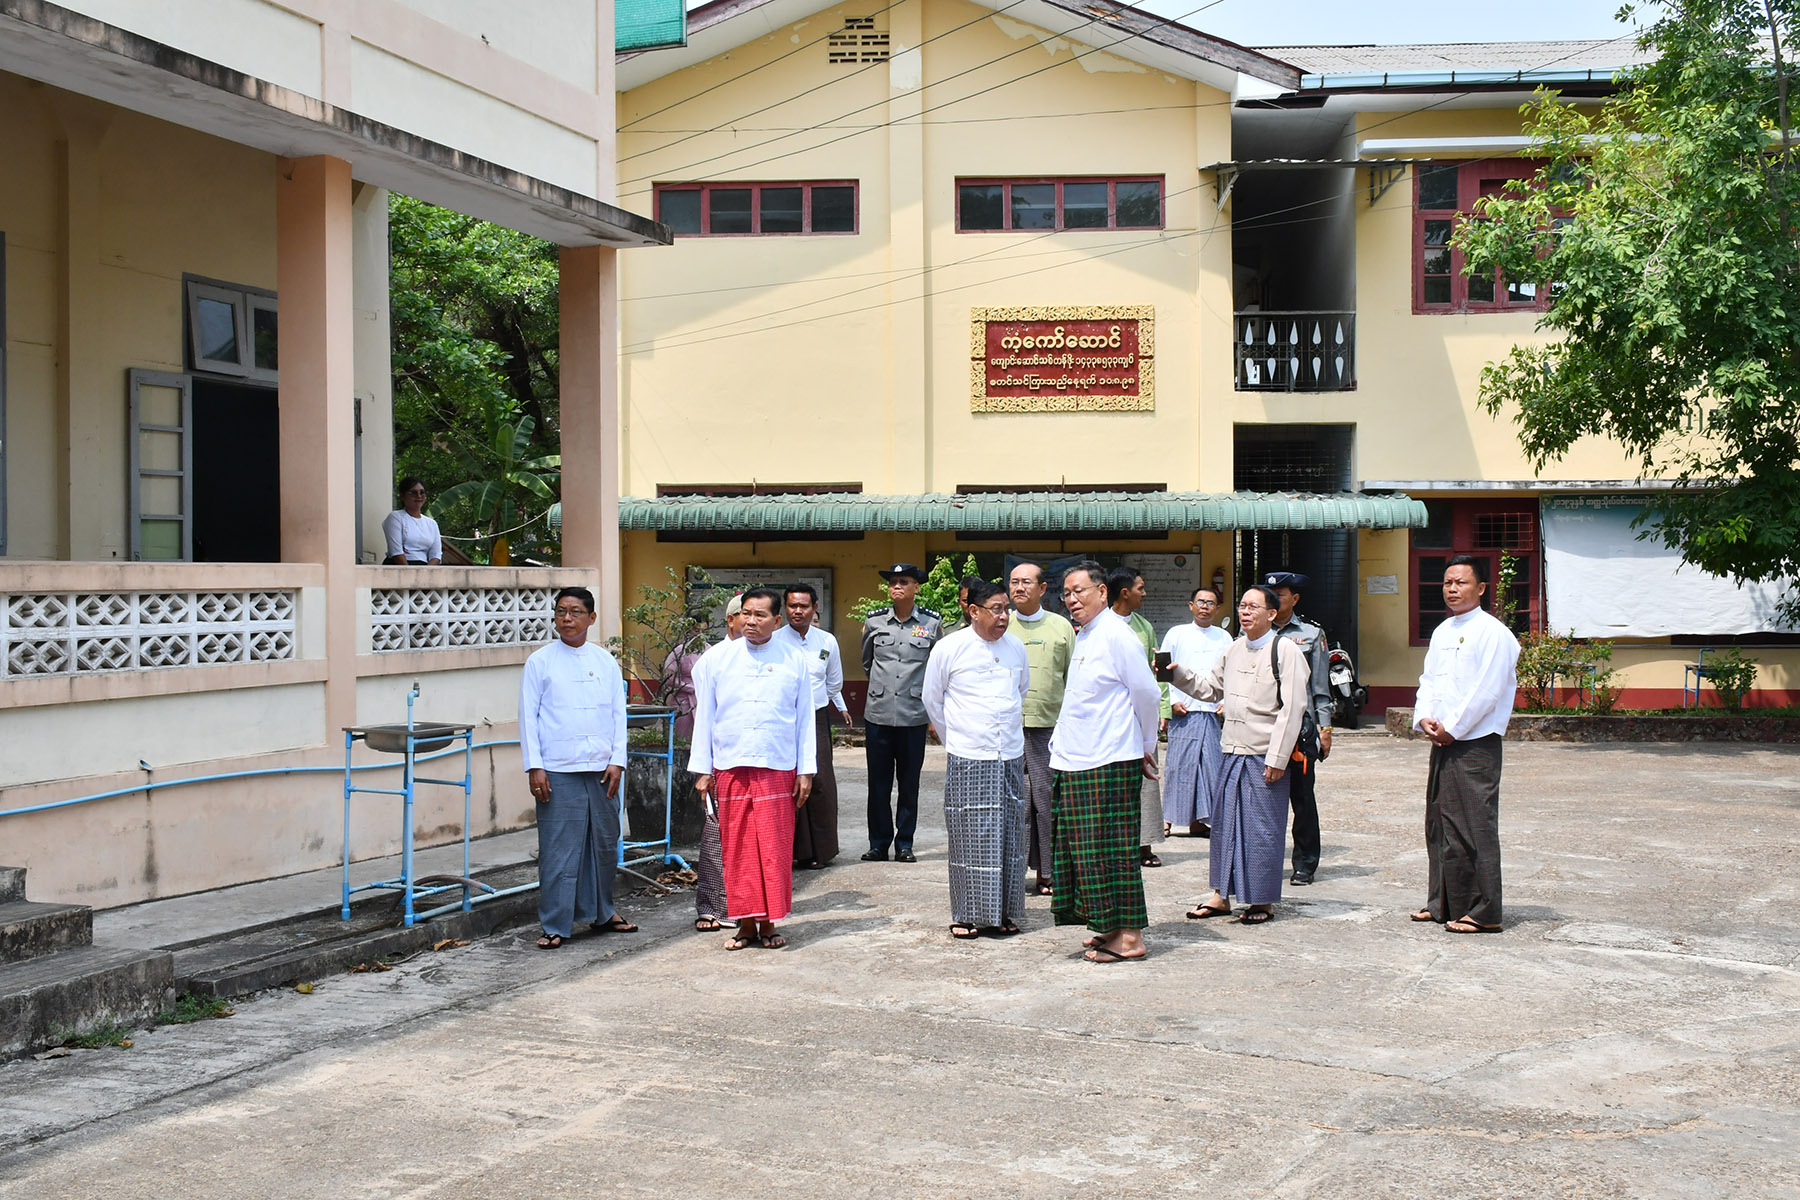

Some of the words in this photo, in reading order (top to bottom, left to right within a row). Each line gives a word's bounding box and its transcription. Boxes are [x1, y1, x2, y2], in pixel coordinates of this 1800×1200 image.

[1001, 325, 1121, 353] ကံ့ကော်ဆောင်
